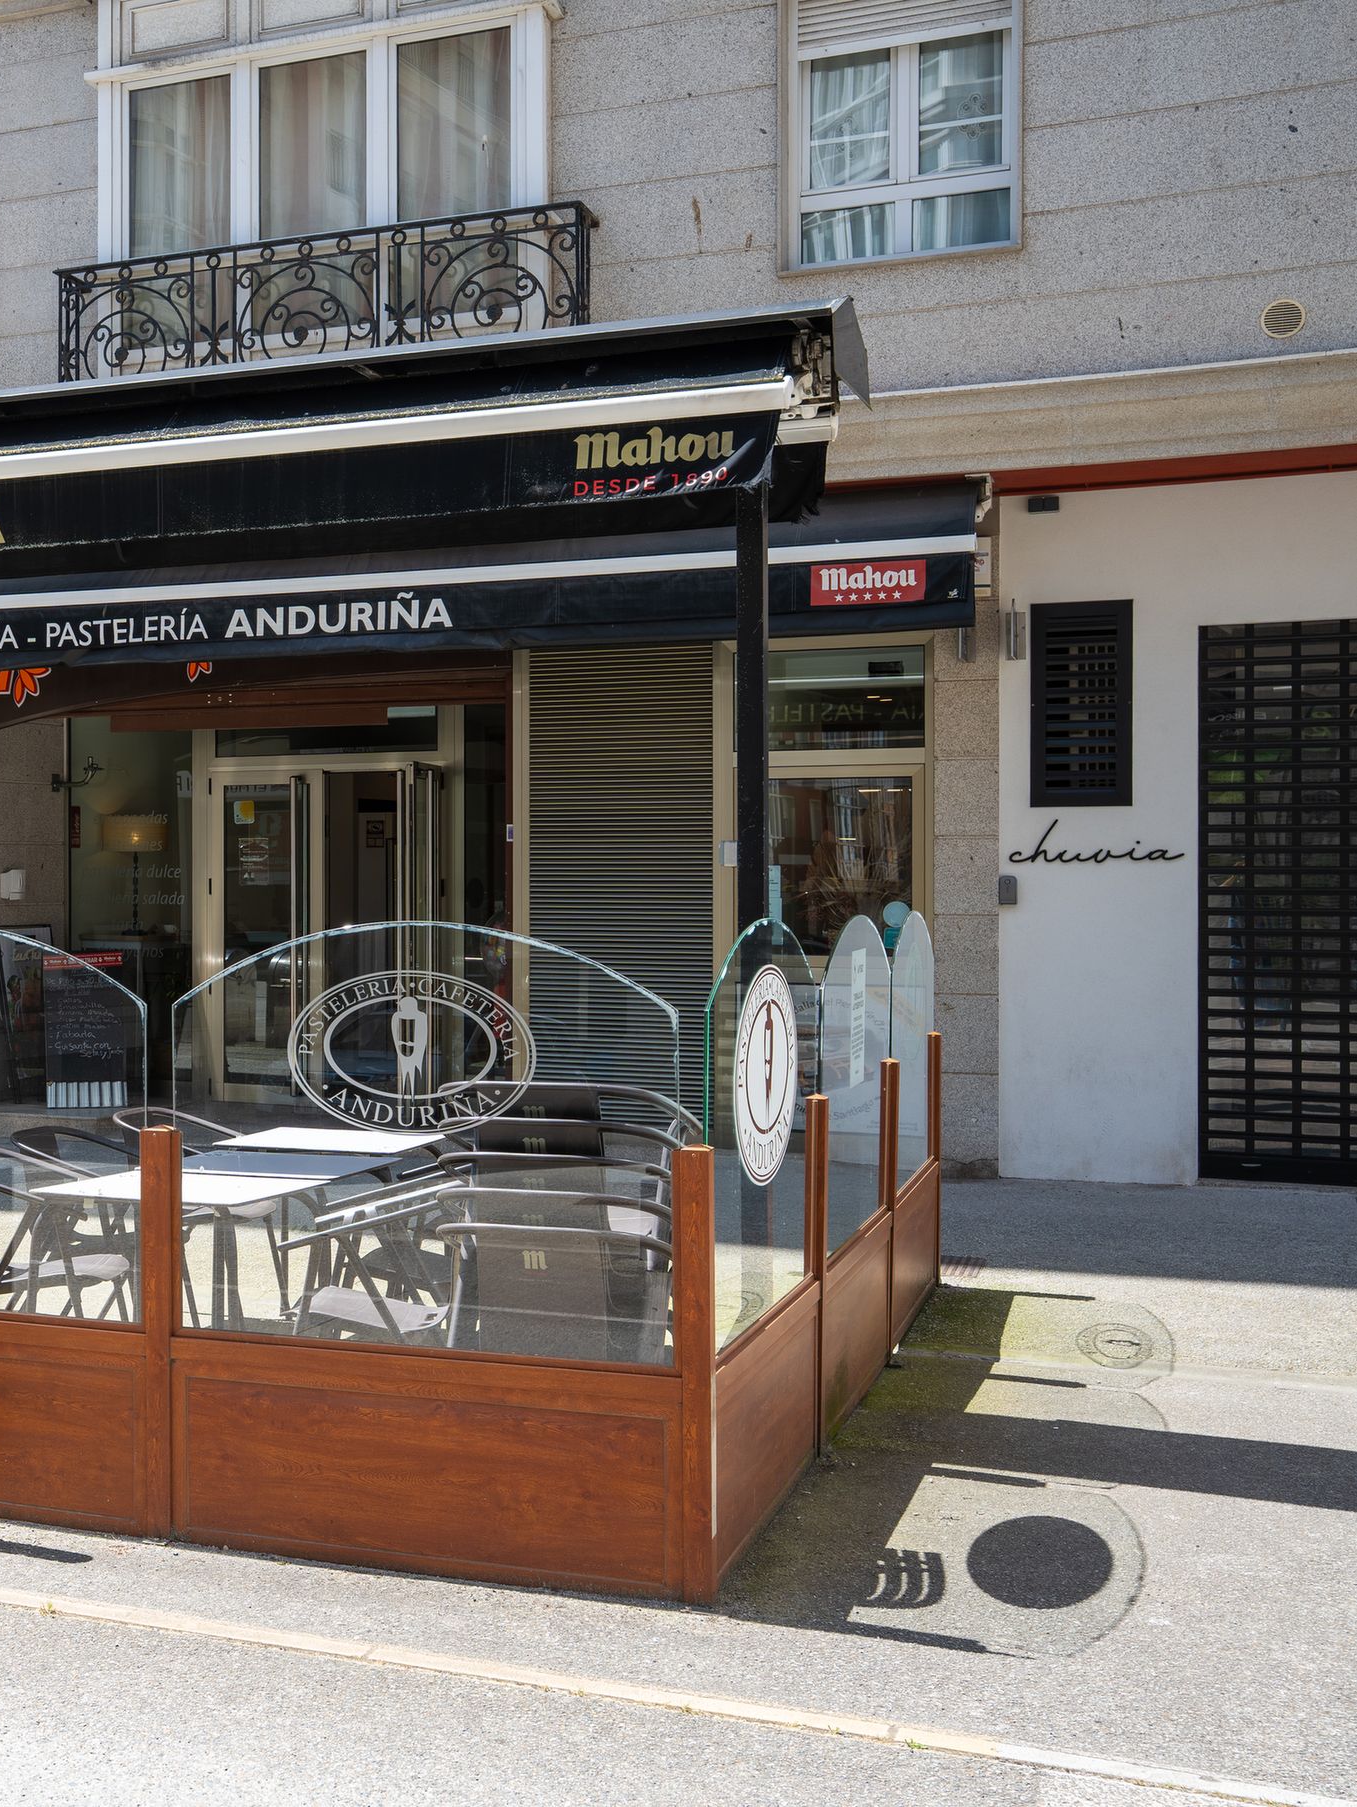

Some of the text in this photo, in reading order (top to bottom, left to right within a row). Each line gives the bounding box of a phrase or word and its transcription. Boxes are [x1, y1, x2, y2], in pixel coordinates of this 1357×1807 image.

[573, 426, 736, 470] Mahou
[573, 466, 728, 496] DESDE 1890
[819, 565, 918, 591] Mahou
[45, 607, 209, 649] PASTELERÍA
[224, 592, 454, 637] ANDURIÑA
[1008, 818, 1185, 864] chuvia
[147, 863, 182, 879] dulce
[142, 890, 186, 905] salada
[299, 978, 521, 1062] PASTELERIA CAFETERIA
[327, 1088, 497, 1128] ANDURIÑA
